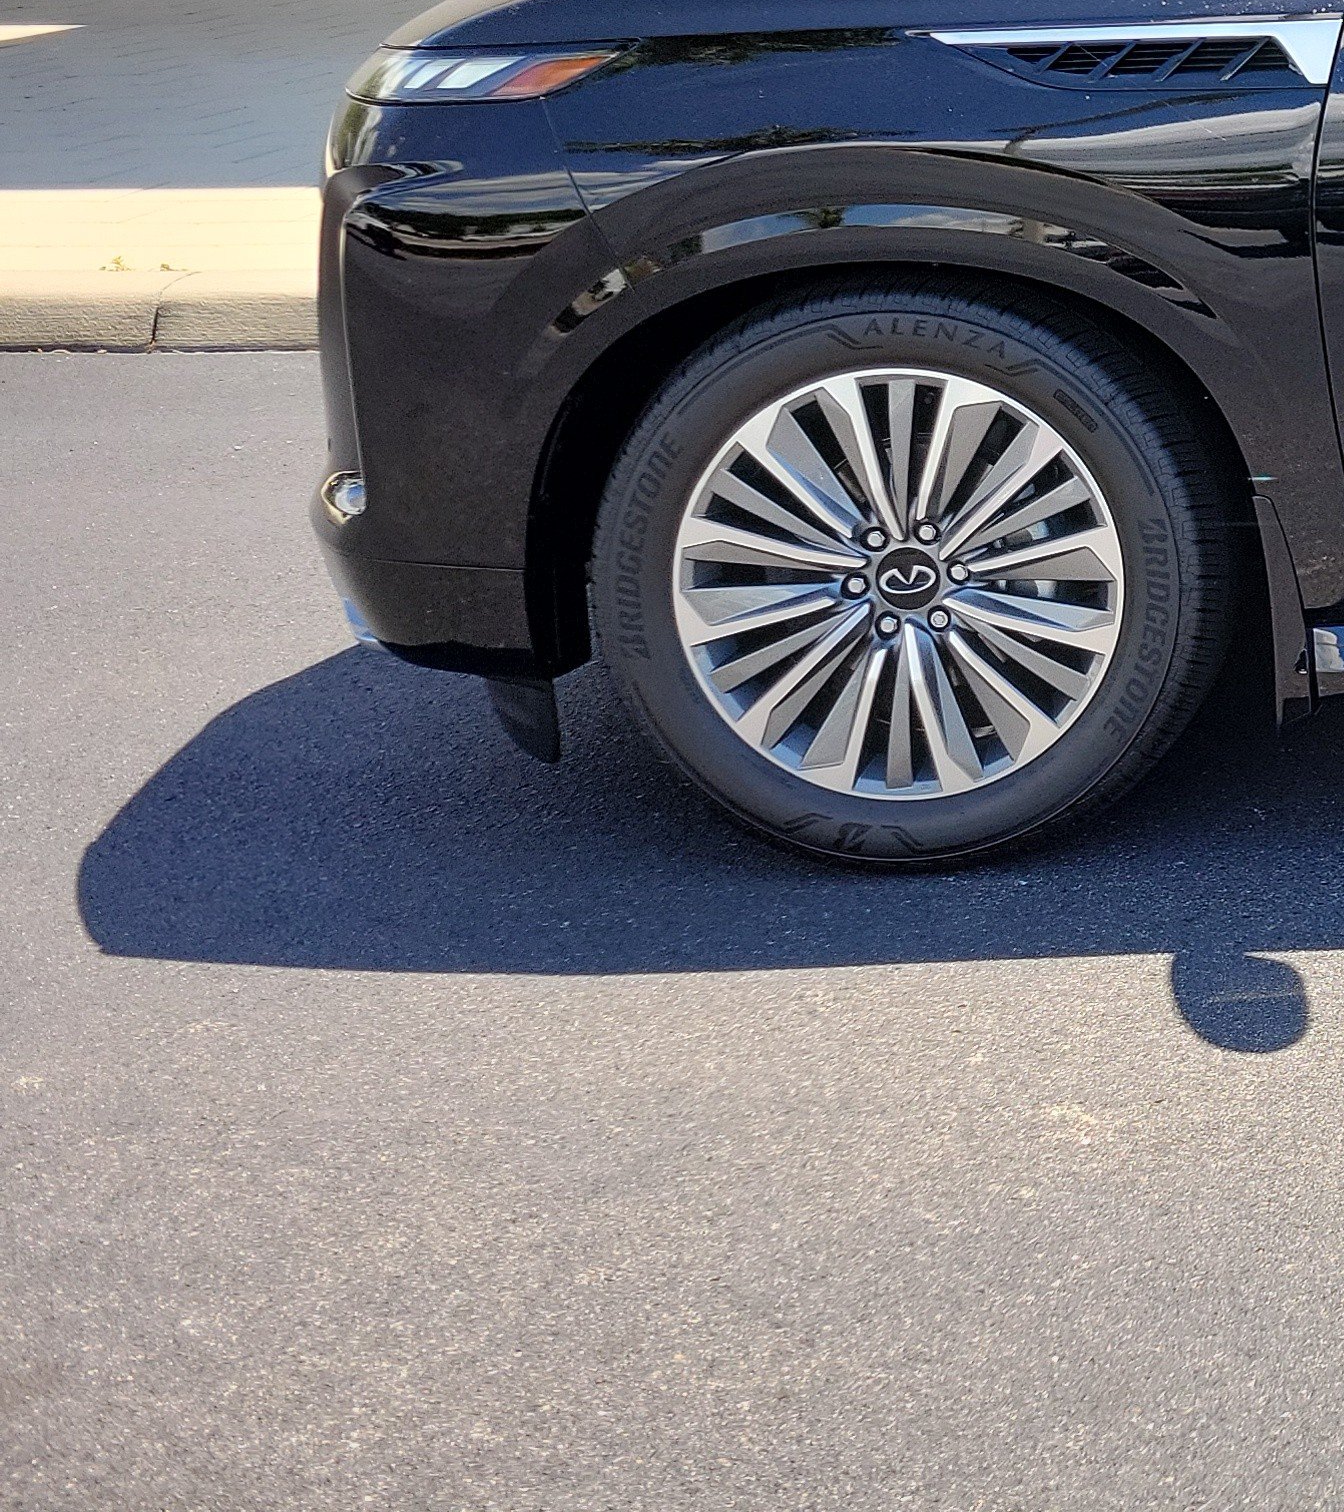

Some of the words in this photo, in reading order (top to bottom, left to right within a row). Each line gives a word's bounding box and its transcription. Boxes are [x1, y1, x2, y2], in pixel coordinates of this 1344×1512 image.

[862, 316, 1006, 360] ALENZA
[616, 431, 683, 661] BRIDGESTONE
[1103, 516, 1172, 740] BRIDGESTONE
